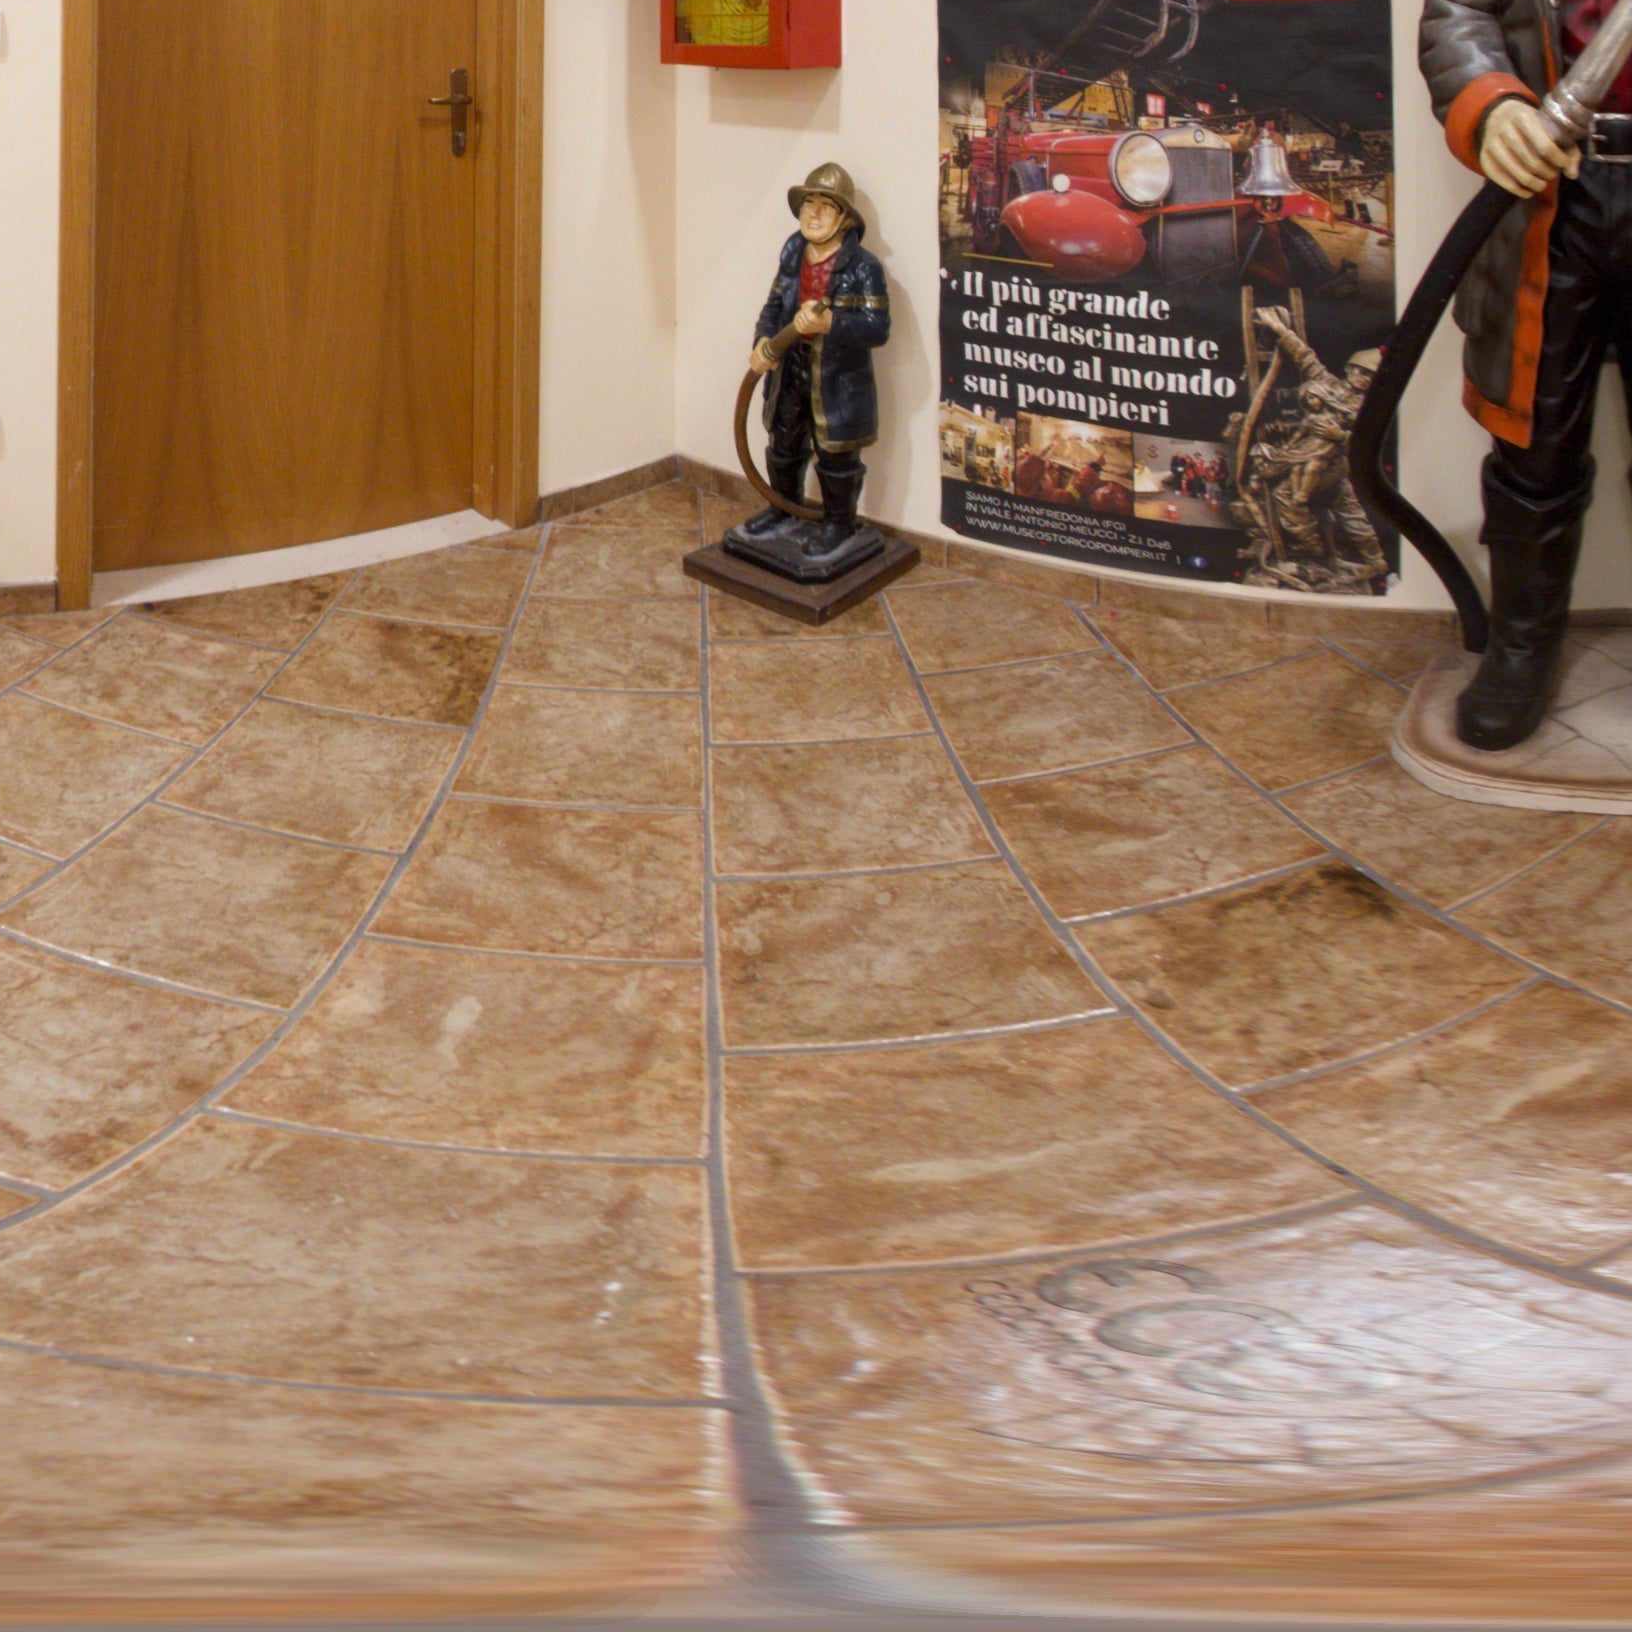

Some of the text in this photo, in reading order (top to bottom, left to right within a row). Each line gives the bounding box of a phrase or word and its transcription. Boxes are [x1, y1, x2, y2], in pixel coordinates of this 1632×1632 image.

[963, 270, 1171, 321] Il più grande
[962, 307, 1219, 361] ed affascinante
[963, 341, 1237, 399] museo al mondo
[963, 373, 1170, 427] sui pompieri
[965, 490, 1002, 507] SIAMO
[1003, 500, 1012, 509] A
[1012, 502, 1101, 527] MANFREDONIA
[965, 502, 978, 514] IN
[979, 505, 1013, 520] VIALE
[1014, 513, 1068, 532] ANTONIO
[1069, 525, 1118, 541] MEUCCI
